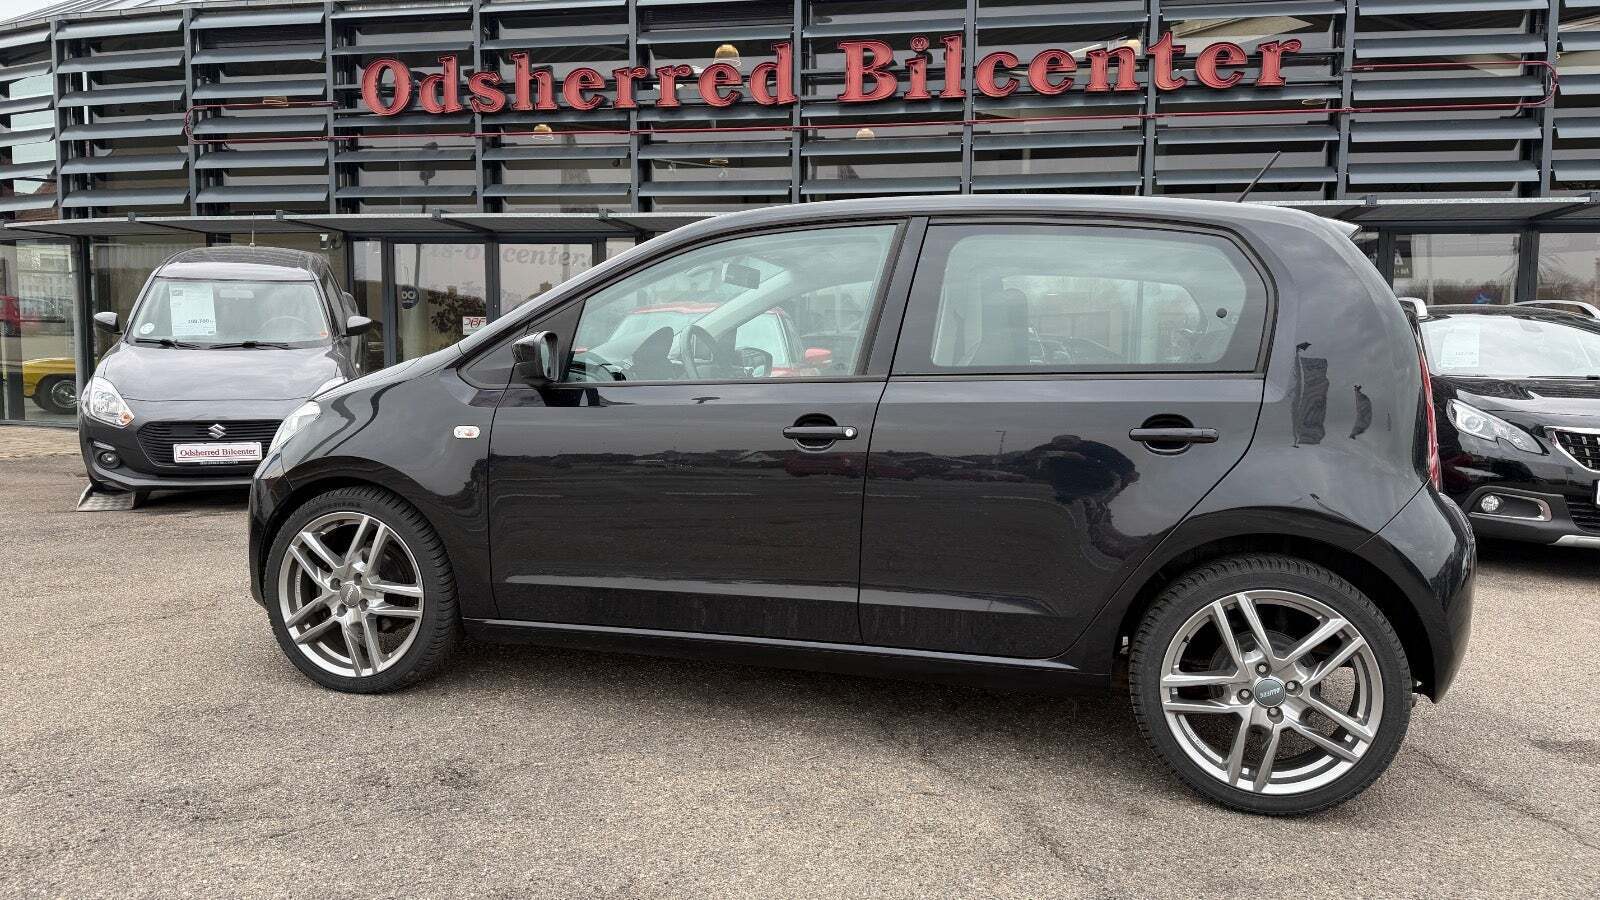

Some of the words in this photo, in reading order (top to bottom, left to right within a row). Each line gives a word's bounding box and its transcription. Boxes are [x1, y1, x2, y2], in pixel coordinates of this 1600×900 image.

[361, 40, 798, 116] Odsherred
[837, 31, 1301, 103] Bilcenter
[180, 448, 220, 457] Odsherred
[222, 447, 256, 456] Bilcenter
